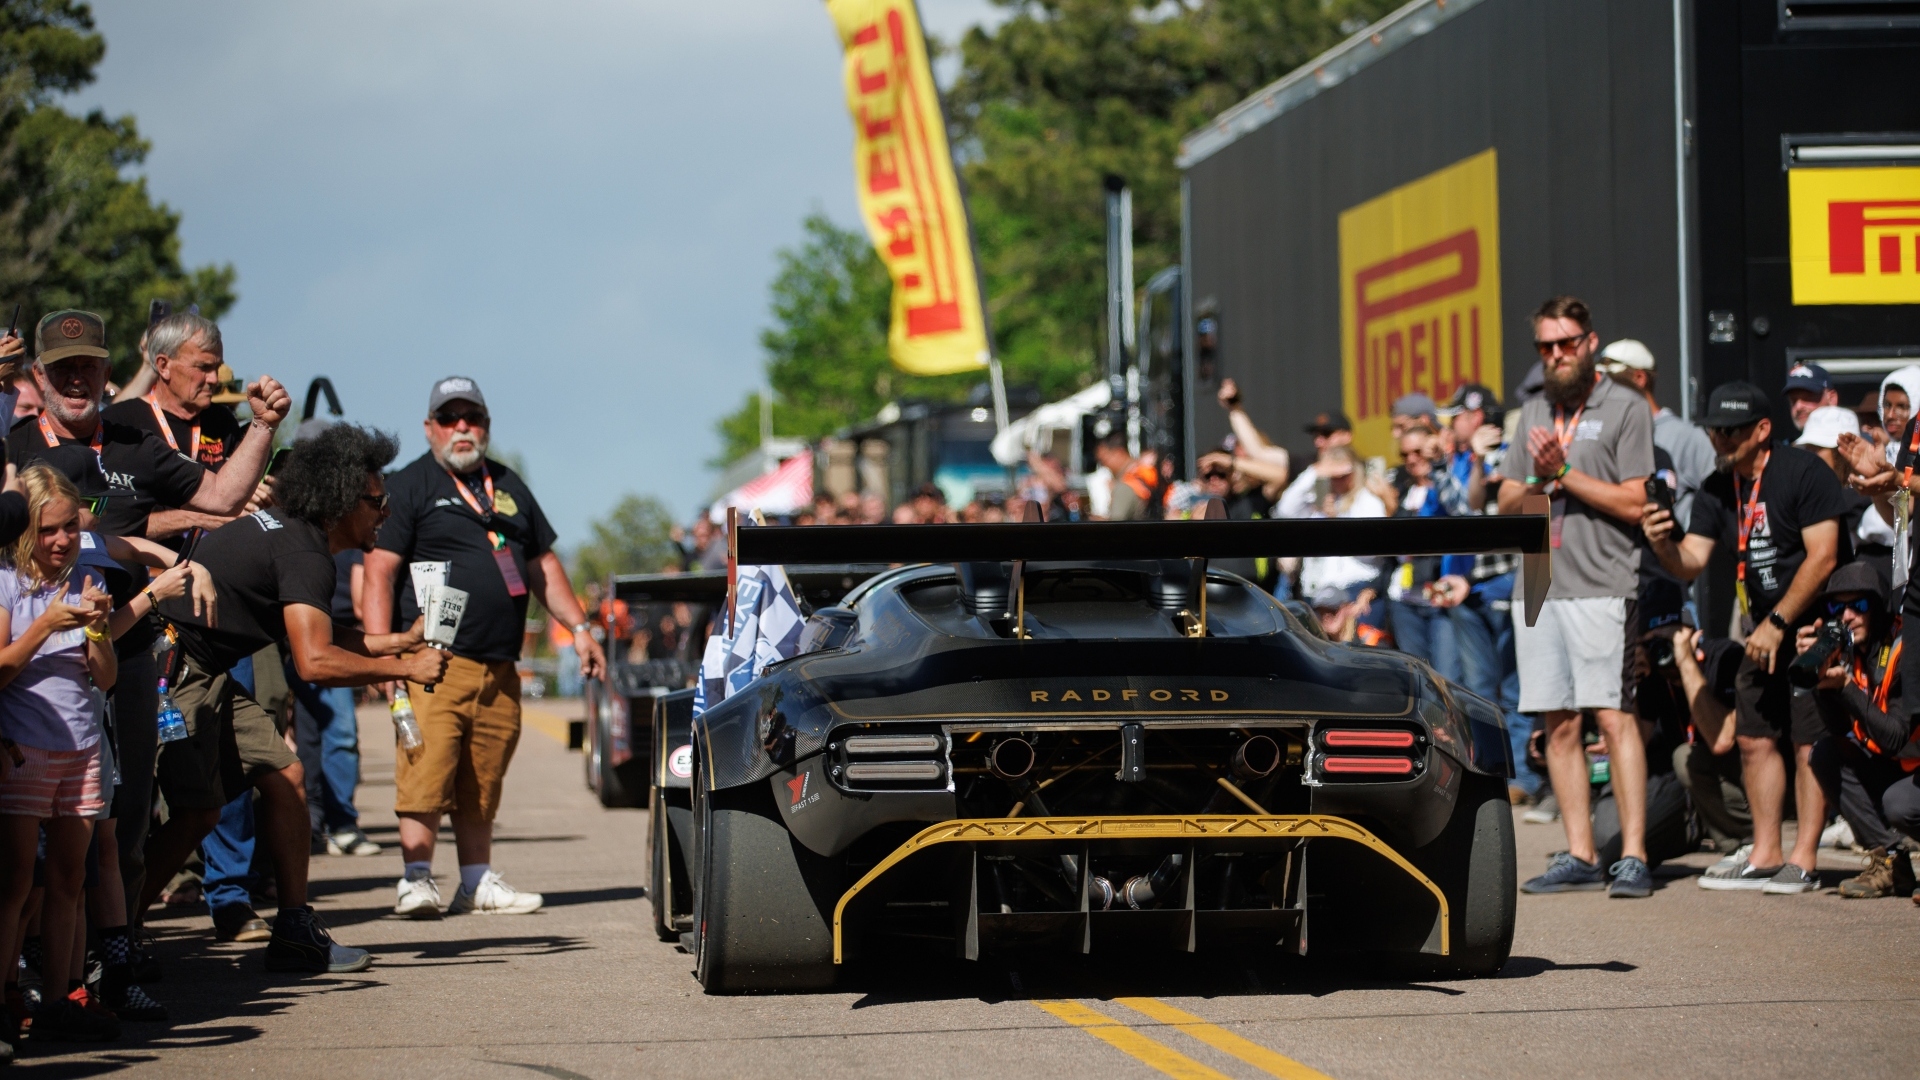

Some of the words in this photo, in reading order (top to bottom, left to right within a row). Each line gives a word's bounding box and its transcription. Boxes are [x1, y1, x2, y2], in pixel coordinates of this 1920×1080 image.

[1355, 226, 1480, 420] PIRELLI
[443, 600, 462, 612] BELL
[1031, 689, 1229, 702] RADFORD
[795, 800, 807, 810] FAST
